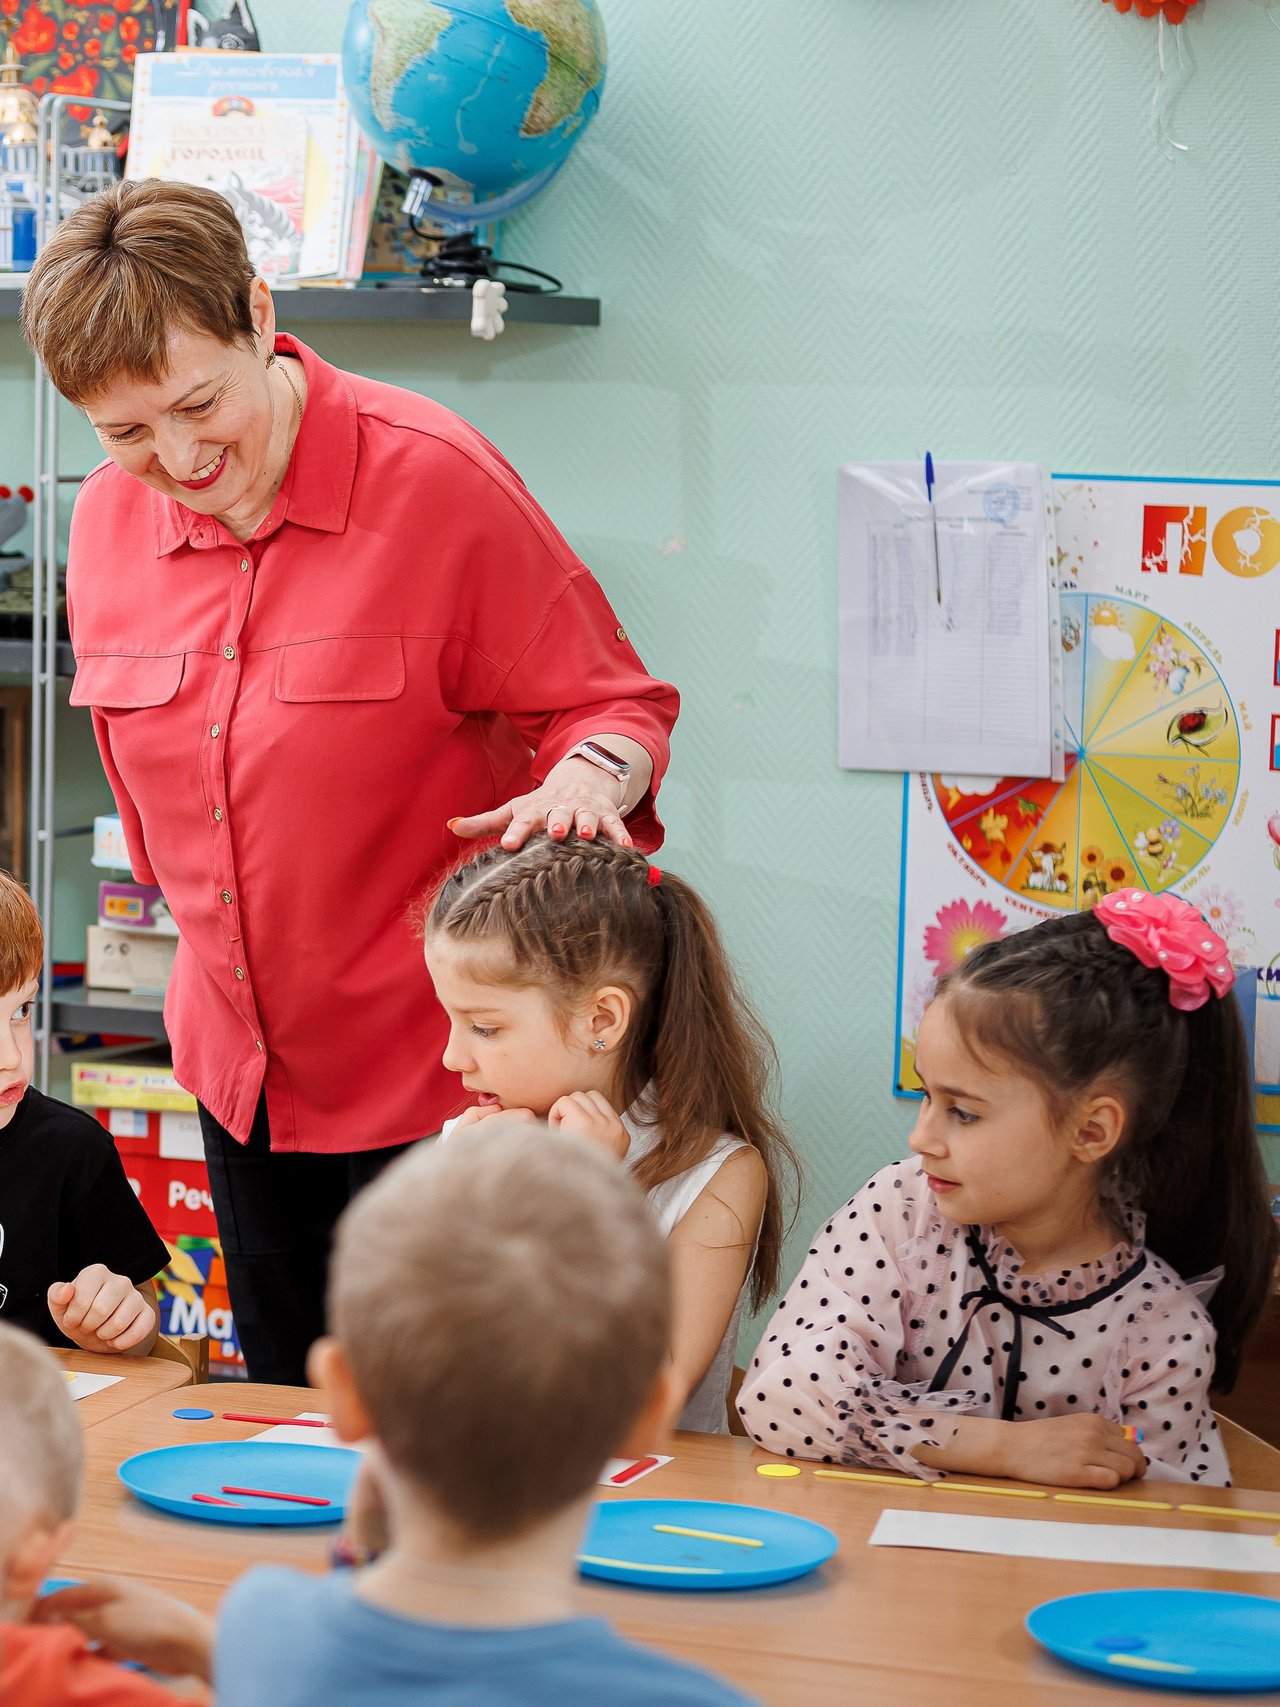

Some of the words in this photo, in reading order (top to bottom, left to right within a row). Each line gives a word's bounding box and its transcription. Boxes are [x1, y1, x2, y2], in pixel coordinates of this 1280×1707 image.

[1113, 584, 1150, 603] МАРТ
[1184, 620, 1222, 664] АПРЕЛЬ
[1239, 701, 1252, 731] МАЙ
[946, 842, 987, 888] ОКТЯБРЬ
[1181, 865, 1211, 893] ИЮЛЬ
